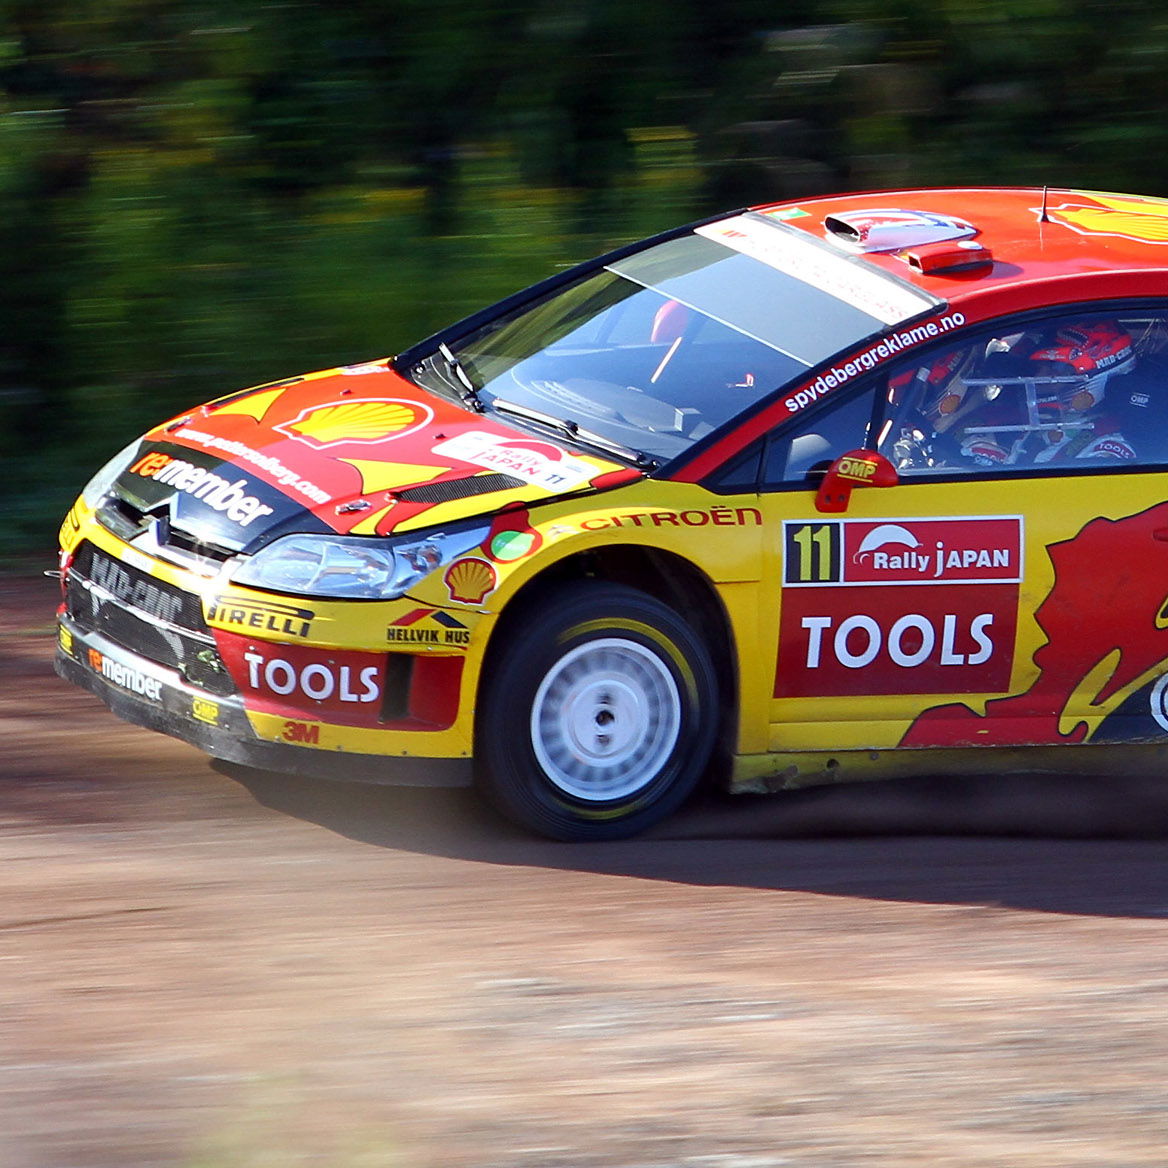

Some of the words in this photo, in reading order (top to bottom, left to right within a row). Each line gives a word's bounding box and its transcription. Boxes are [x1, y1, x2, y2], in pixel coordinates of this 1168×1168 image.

[785, 312, 965, 412] spydebergreklame.no
[499, 449, 543, 466] Rally
[545, 473, 568, 484] 11
[837, 459, 877, 479] OMP
[793, 525, 831, 581] 11
[873, 551, 930, 573] Rally
[387, 628, 439, 643] HELLVIK
[445, 630, 470, 644] HUS
[801, 613, 995, 668] TOOLS
[244, 652, 380, 703] TOOLS
[282, 721, 320, 744] 3M
